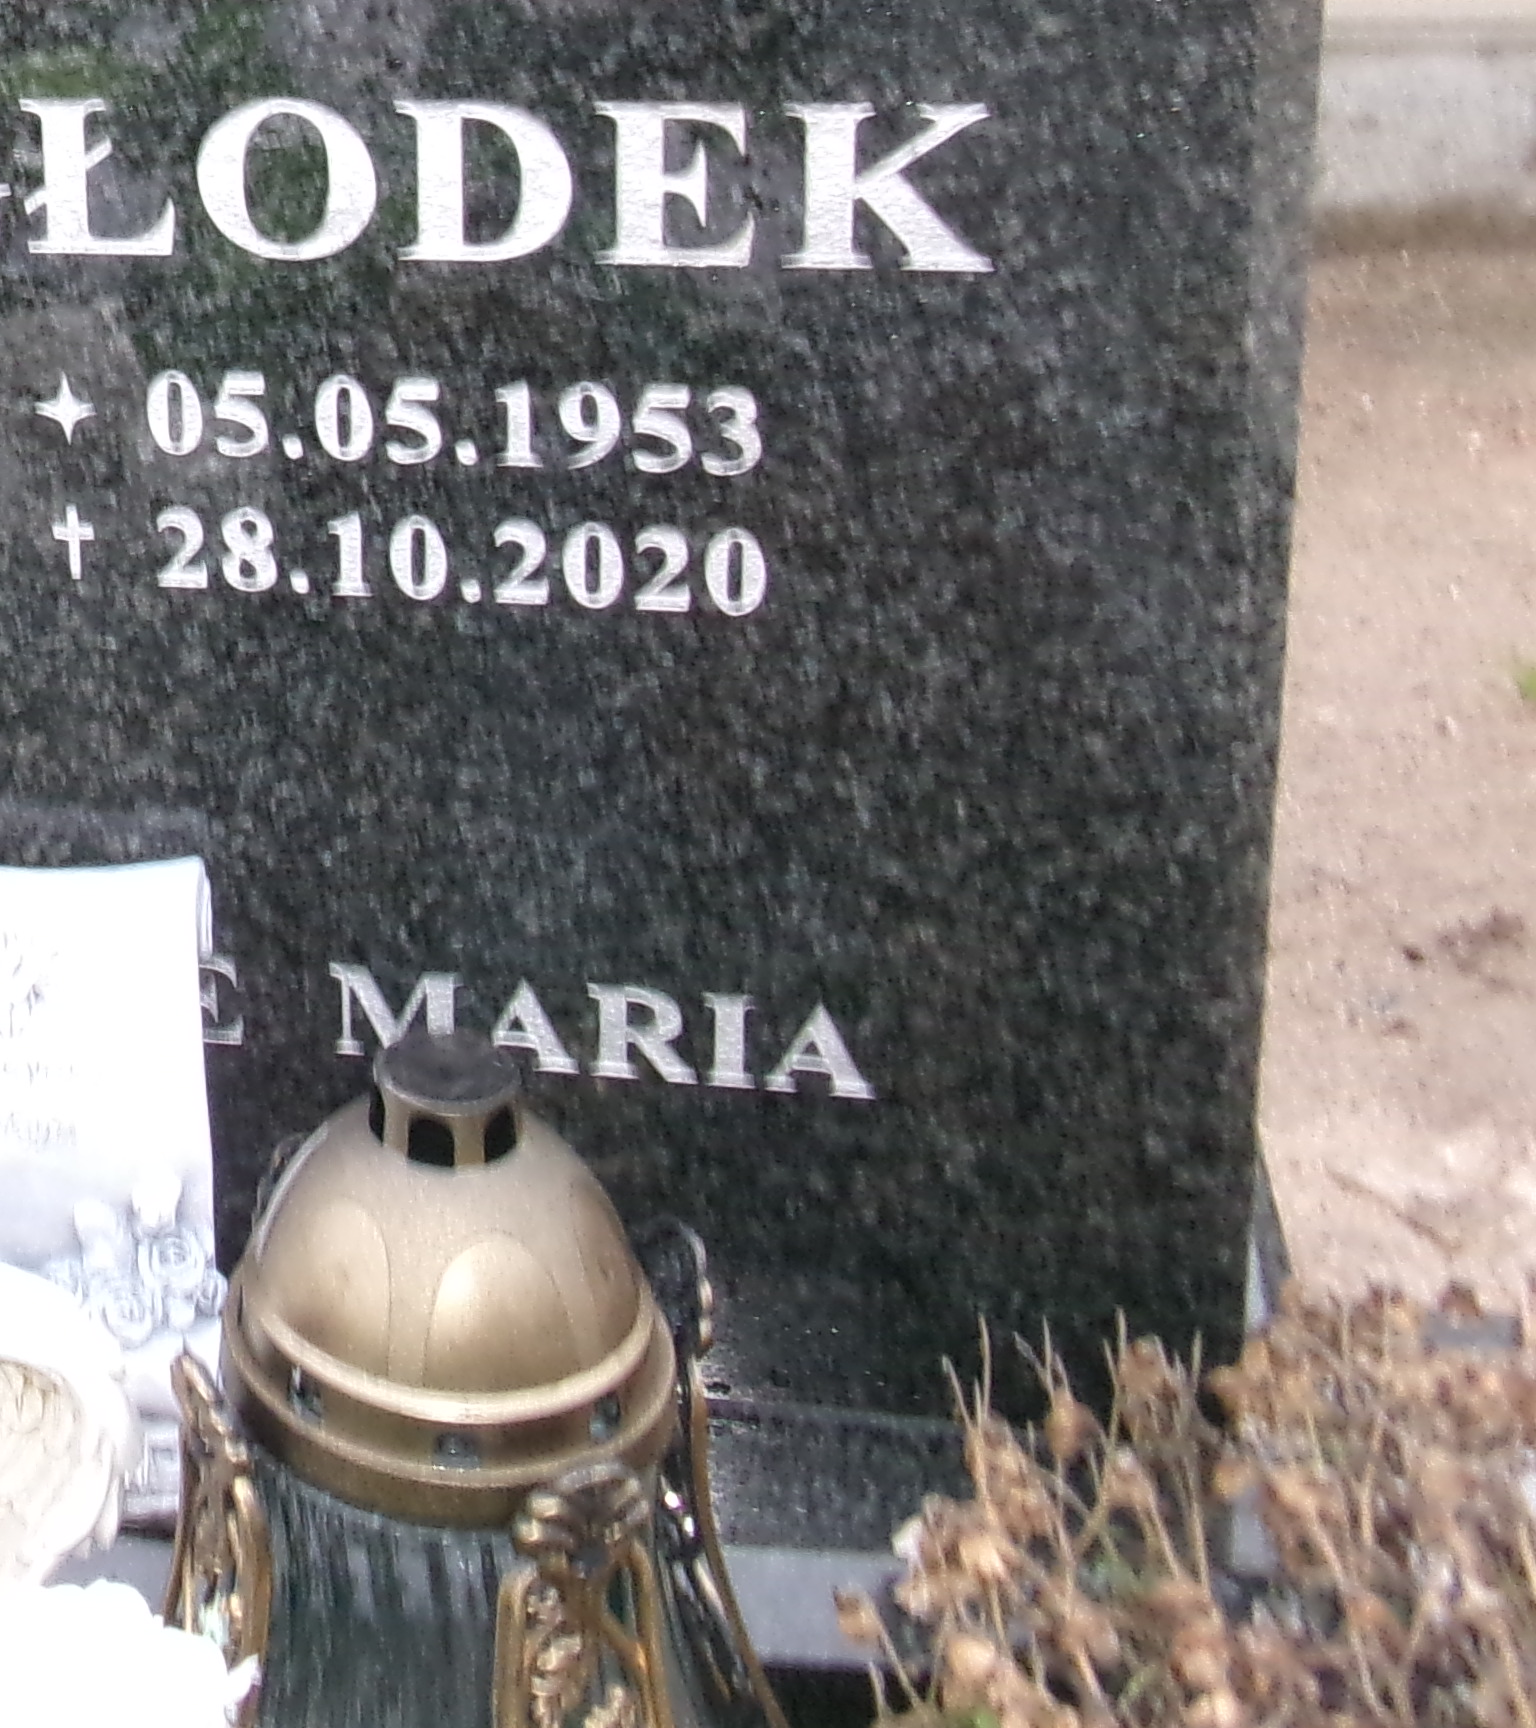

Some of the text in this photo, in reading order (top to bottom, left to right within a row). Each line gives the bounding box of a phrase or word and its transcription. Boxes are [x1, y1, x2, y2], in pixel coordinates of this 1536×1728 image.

[144, 369, 764, 477] 05.05.1953
[154, 504, 769, 617] 28.10.2020
[329, 962, 877, 1100] MARIA
